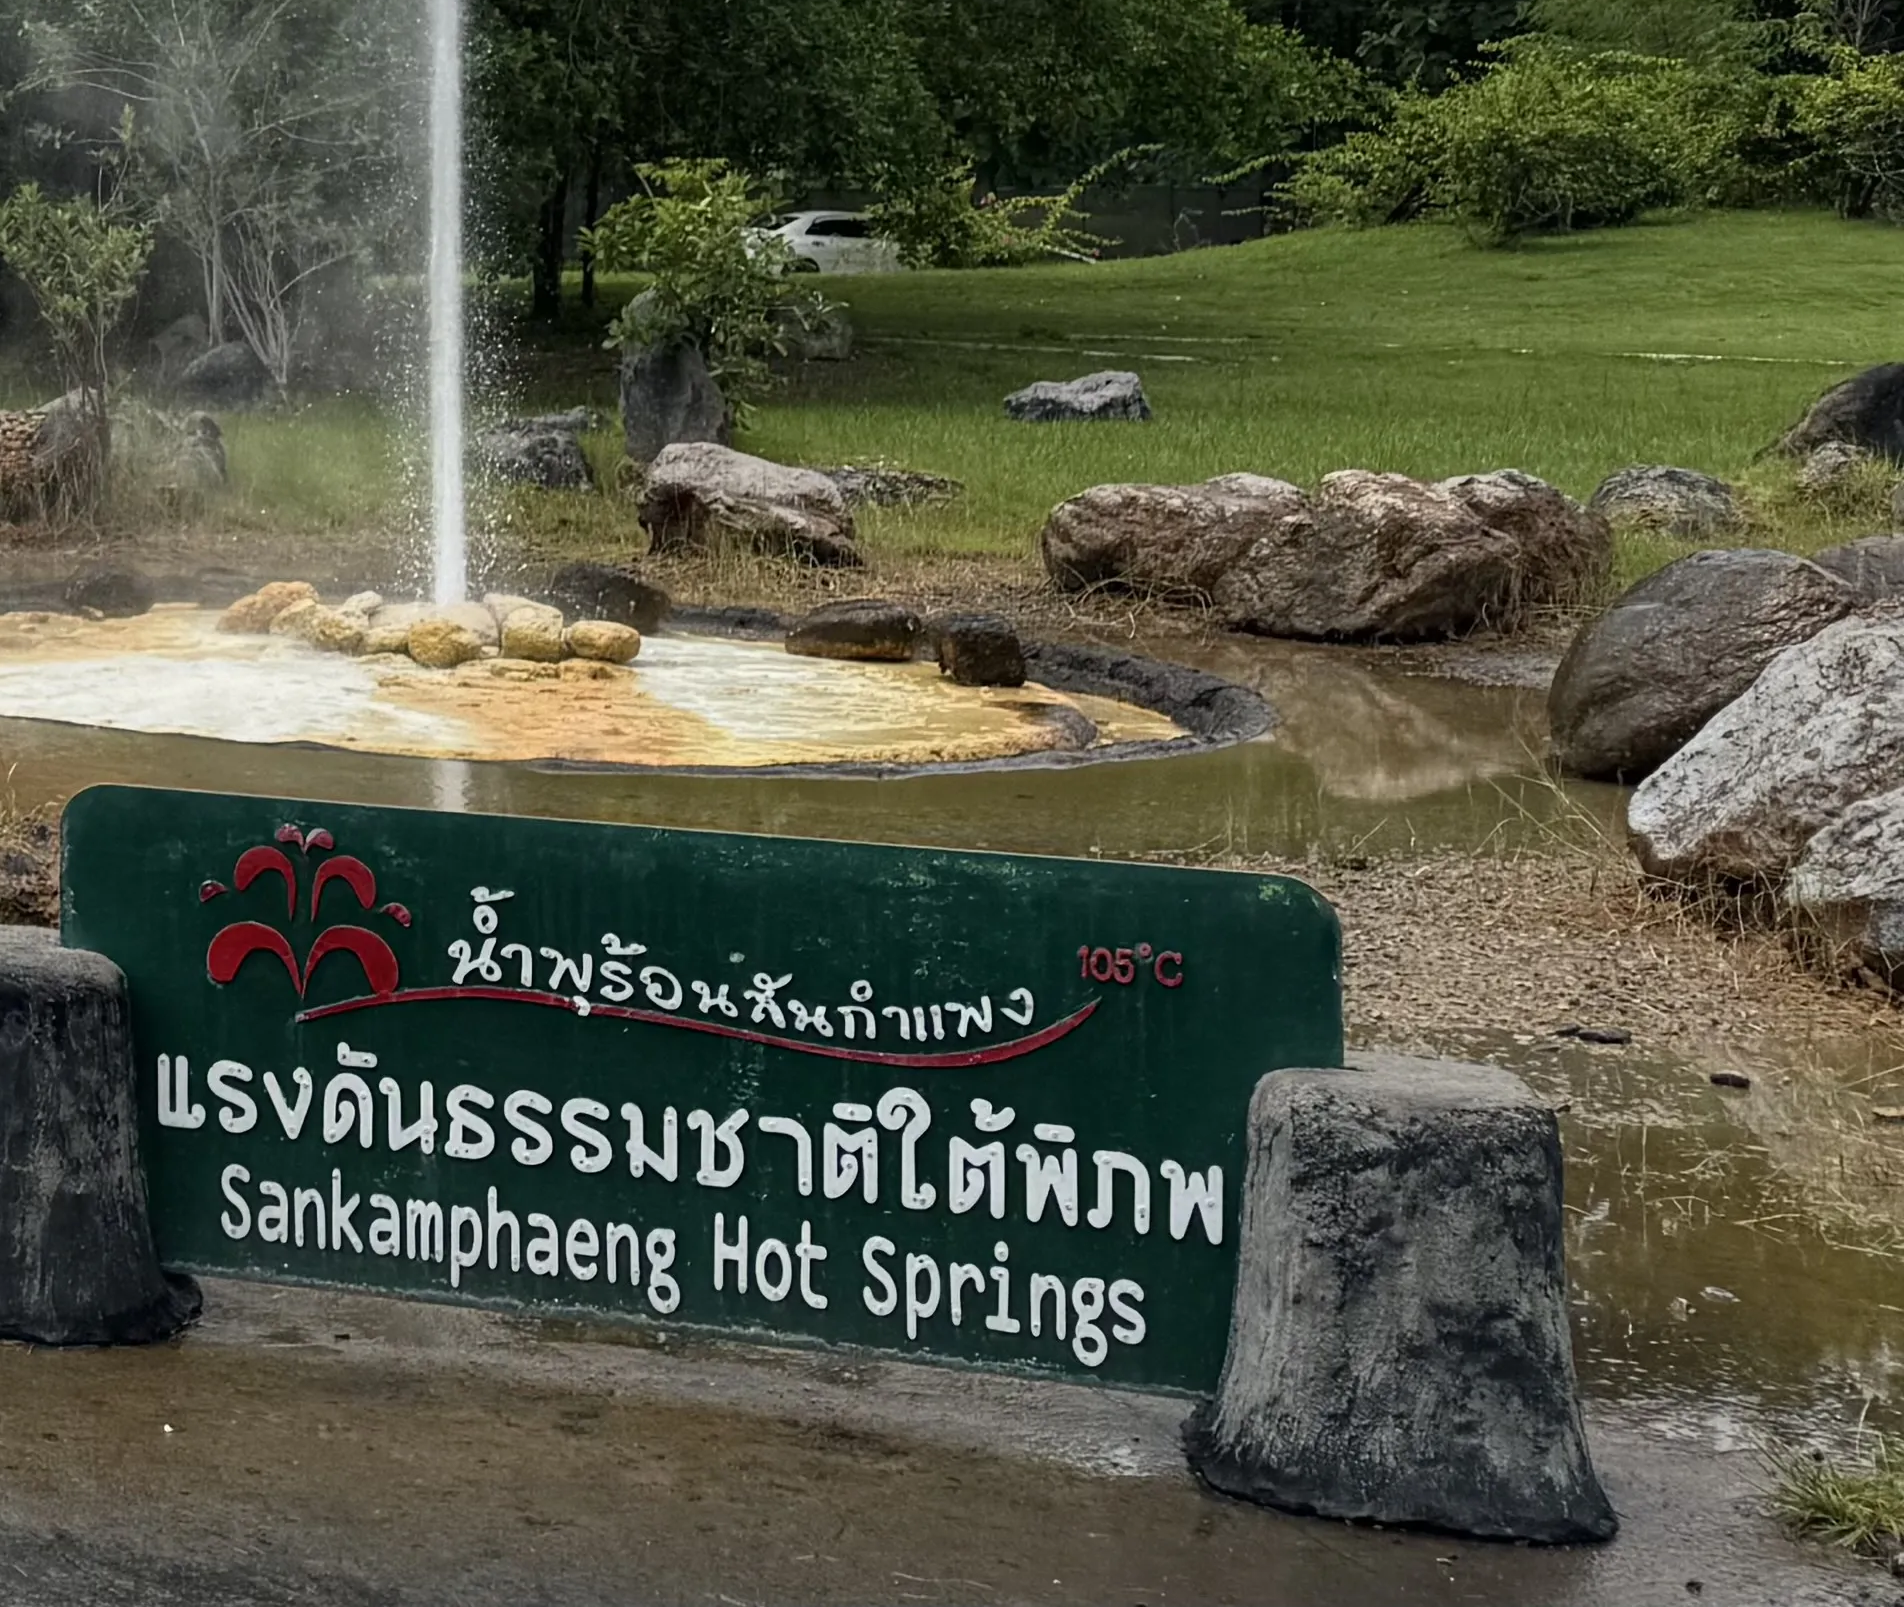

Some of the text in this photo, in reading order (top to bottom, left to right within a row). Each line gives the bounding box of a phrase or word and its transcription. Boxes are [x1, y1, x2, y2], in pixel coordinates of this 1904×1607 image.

[447, 885, 1035, 1042] น้ำพุร้อนสันกำแพง
[1077, 941, 1184, 989] 105°C
[157, 1042, 1224, 1245] แรงดันธรรมชาติใต้พิภพ
[220, 1163, 1147, 1367] Sankamphaeng Hot Springs
